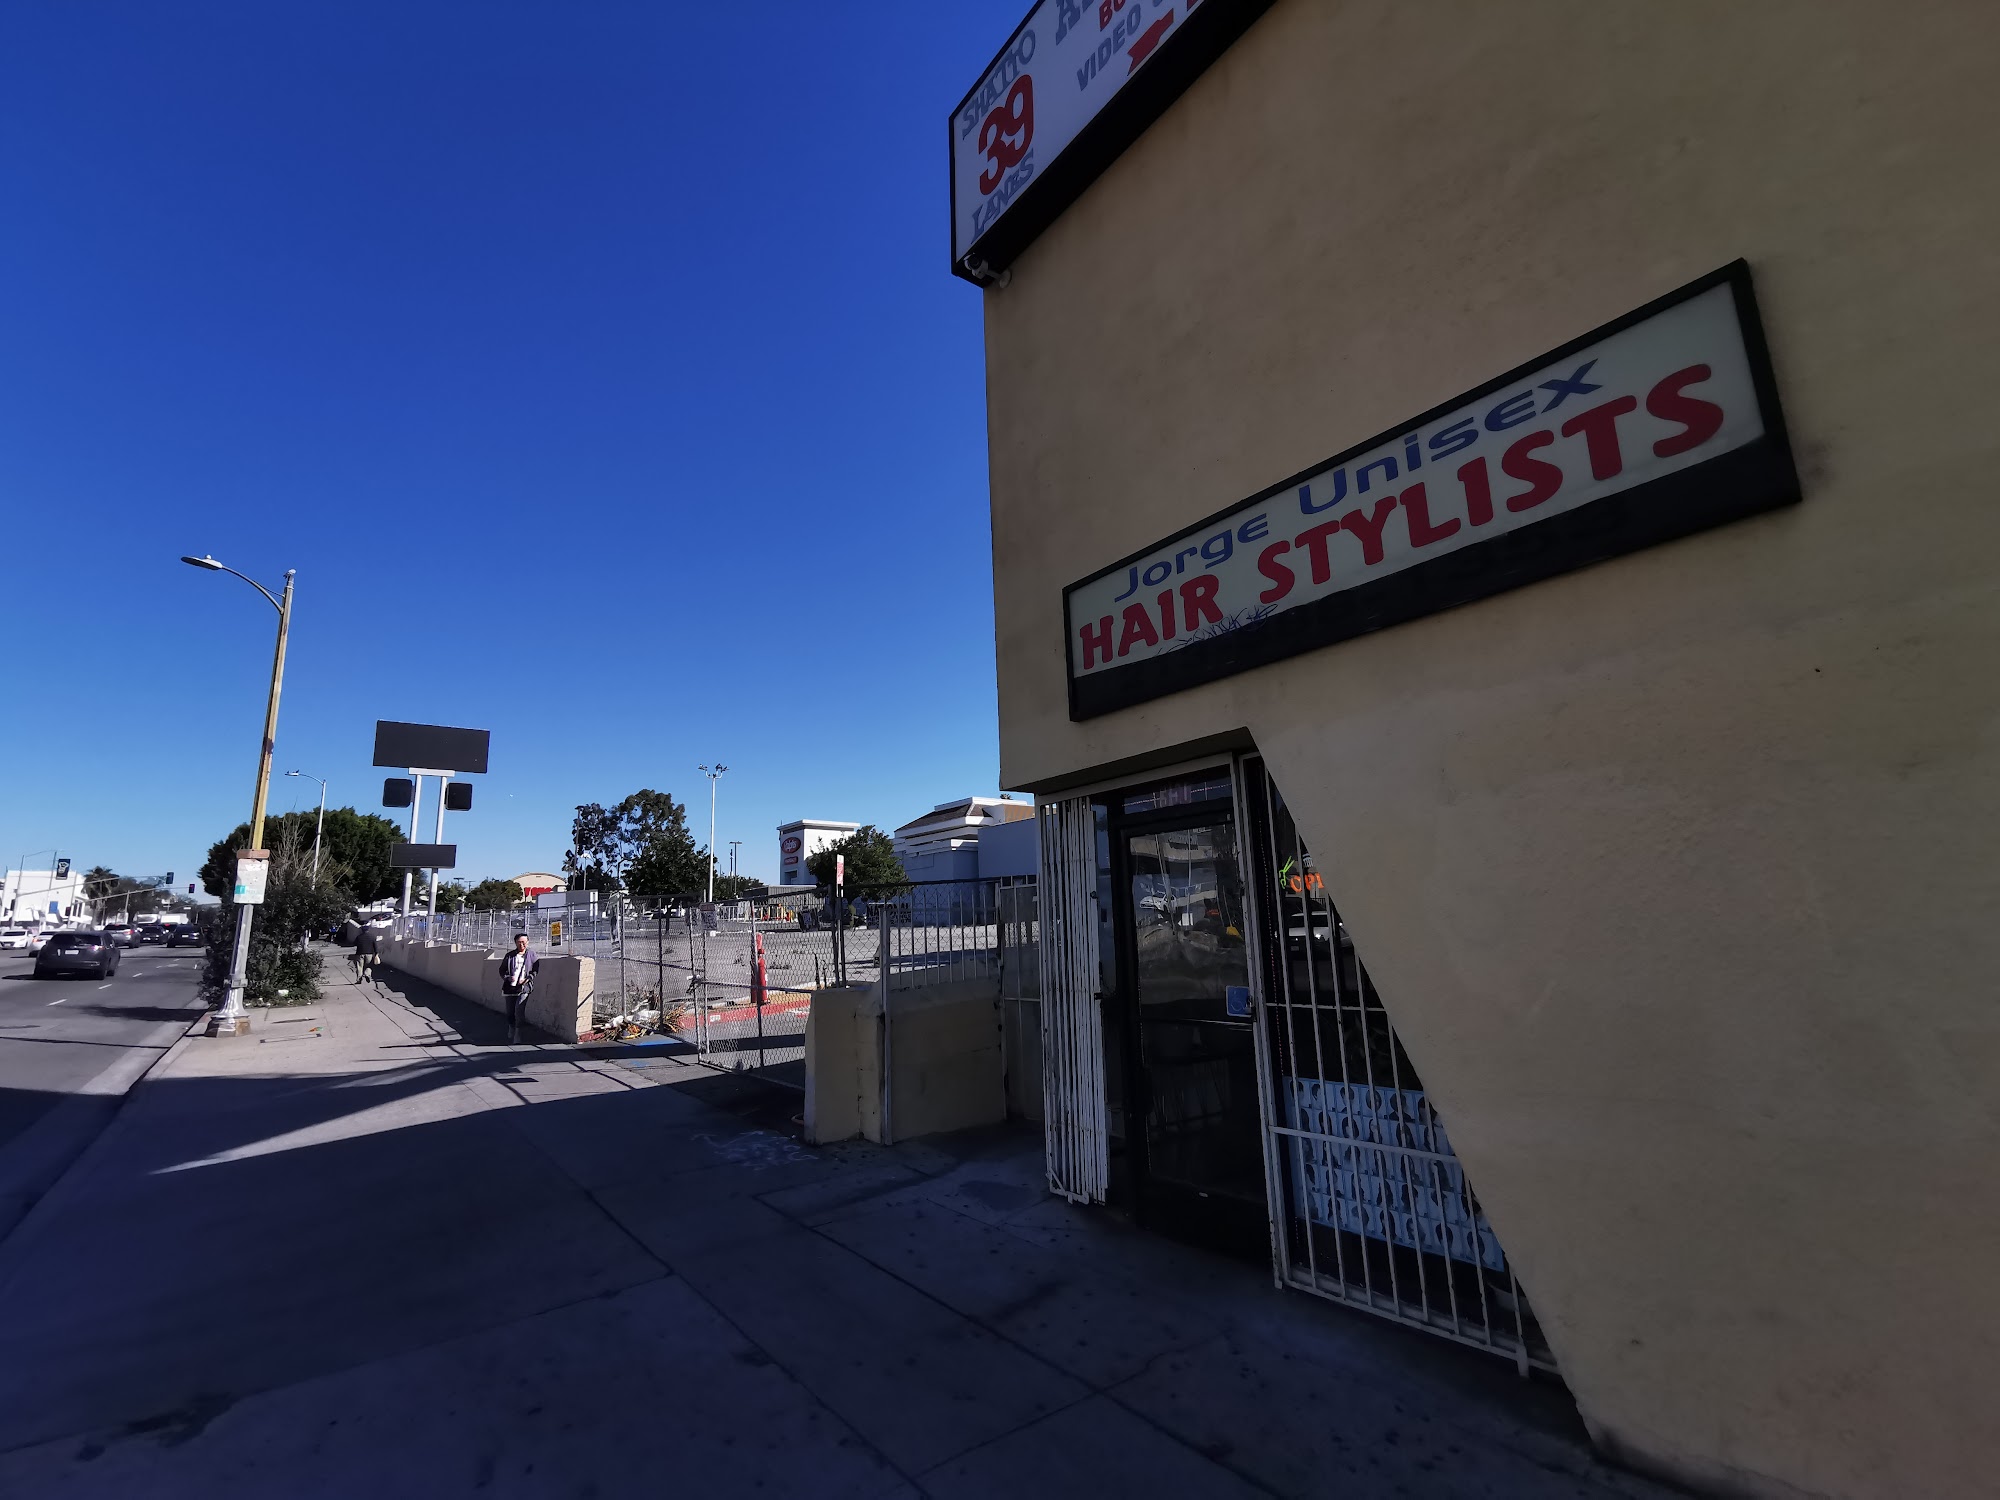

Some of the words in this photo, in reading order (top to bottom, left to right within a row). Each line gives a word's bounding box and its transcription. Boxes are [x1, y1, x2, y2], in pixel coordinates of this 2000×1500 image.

[962, 29, 1036, 141] SHATTO
[1076, 3, 1141, 91] VIDEO
[978, 74, 1034, 196] 39
[970, 148, 1035, 245] LANES
[1081, 574, 1224, 670] HAIR
[1258, 362, 1725, 605] STYLISTS
[1114, 513, 1268, 603] Jorge
